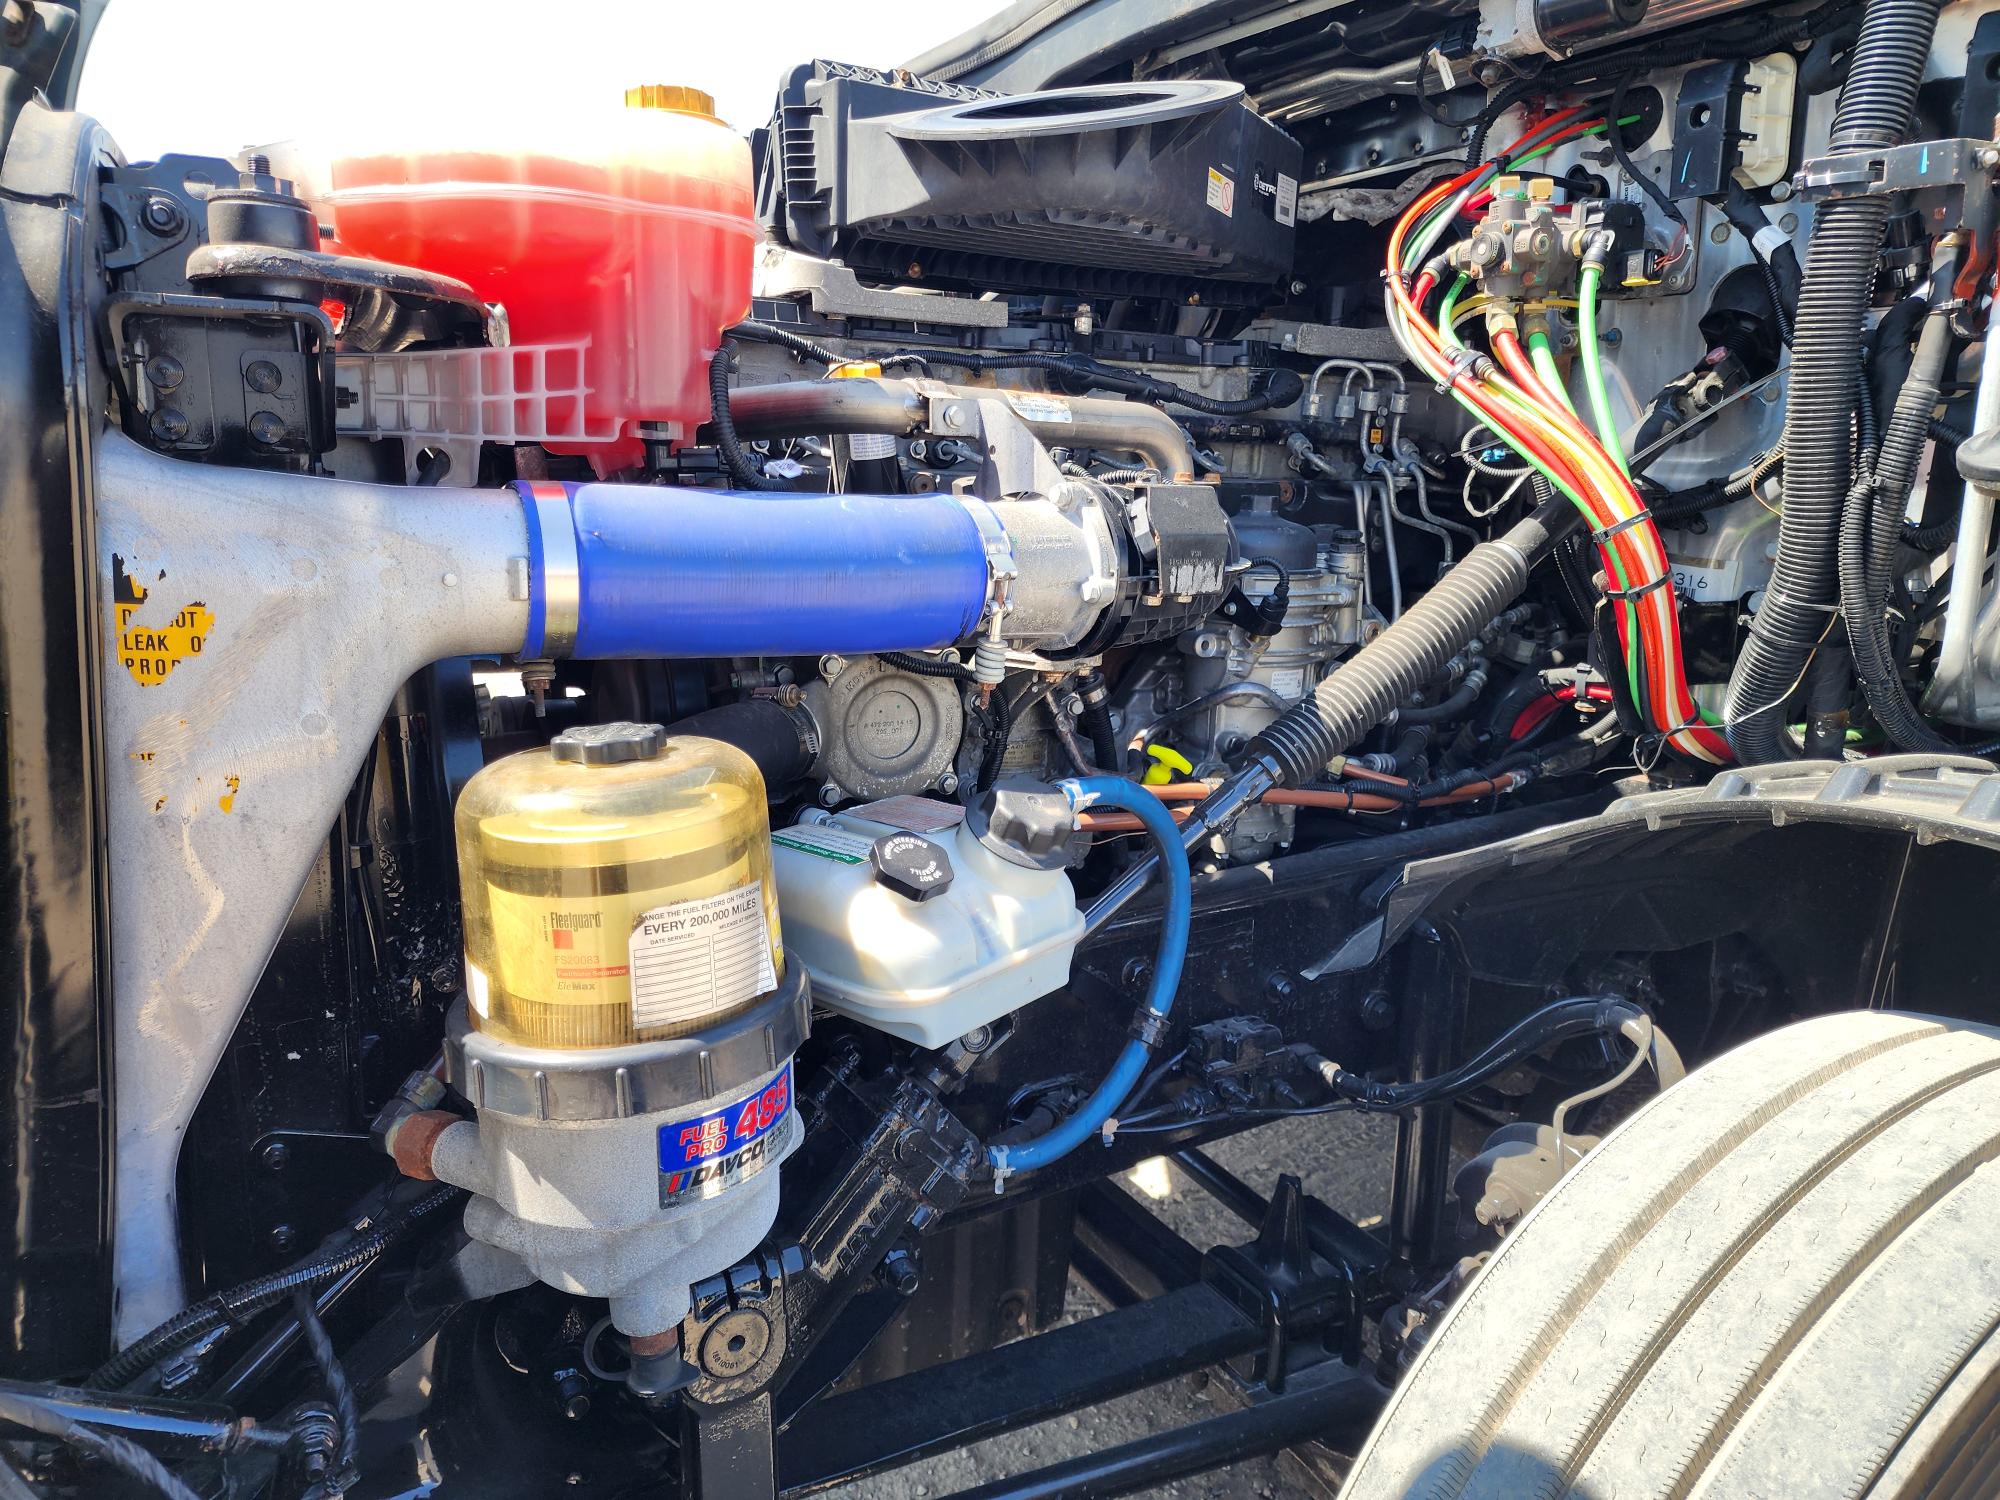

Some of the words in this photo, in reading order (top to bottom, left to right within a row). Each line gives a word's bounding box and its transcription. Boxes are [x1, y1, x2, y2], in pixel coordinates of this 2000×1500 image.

[170, 611, 197, 628] OT
[123, 634, 169, 651] LEAK
[893, 837, 928, 848] STEERING
[893, 844, 914, 853] FLUID
[910, 861, 936, 875] OVERFILL
[644, 913, 665, 921] ANGE
[683, 906, 700, 915] FUEL
[702, 899, 725, 910] FILTERS
[644, 919, 686, 935] EVERY
[690, 909, 729, 927] 200,000
[732, 898, 756, 915] MILES
[550, 912, 601, 932] Fleetguard
[668, 933, 695, 941] SERVICED
[734, 1072, 788, 1140] 485
[679, 1117, 728, 1146] FUEL
[685, 1133, 728, 1161] PRO
[691, 1139, 765, 1188] DAVCO
